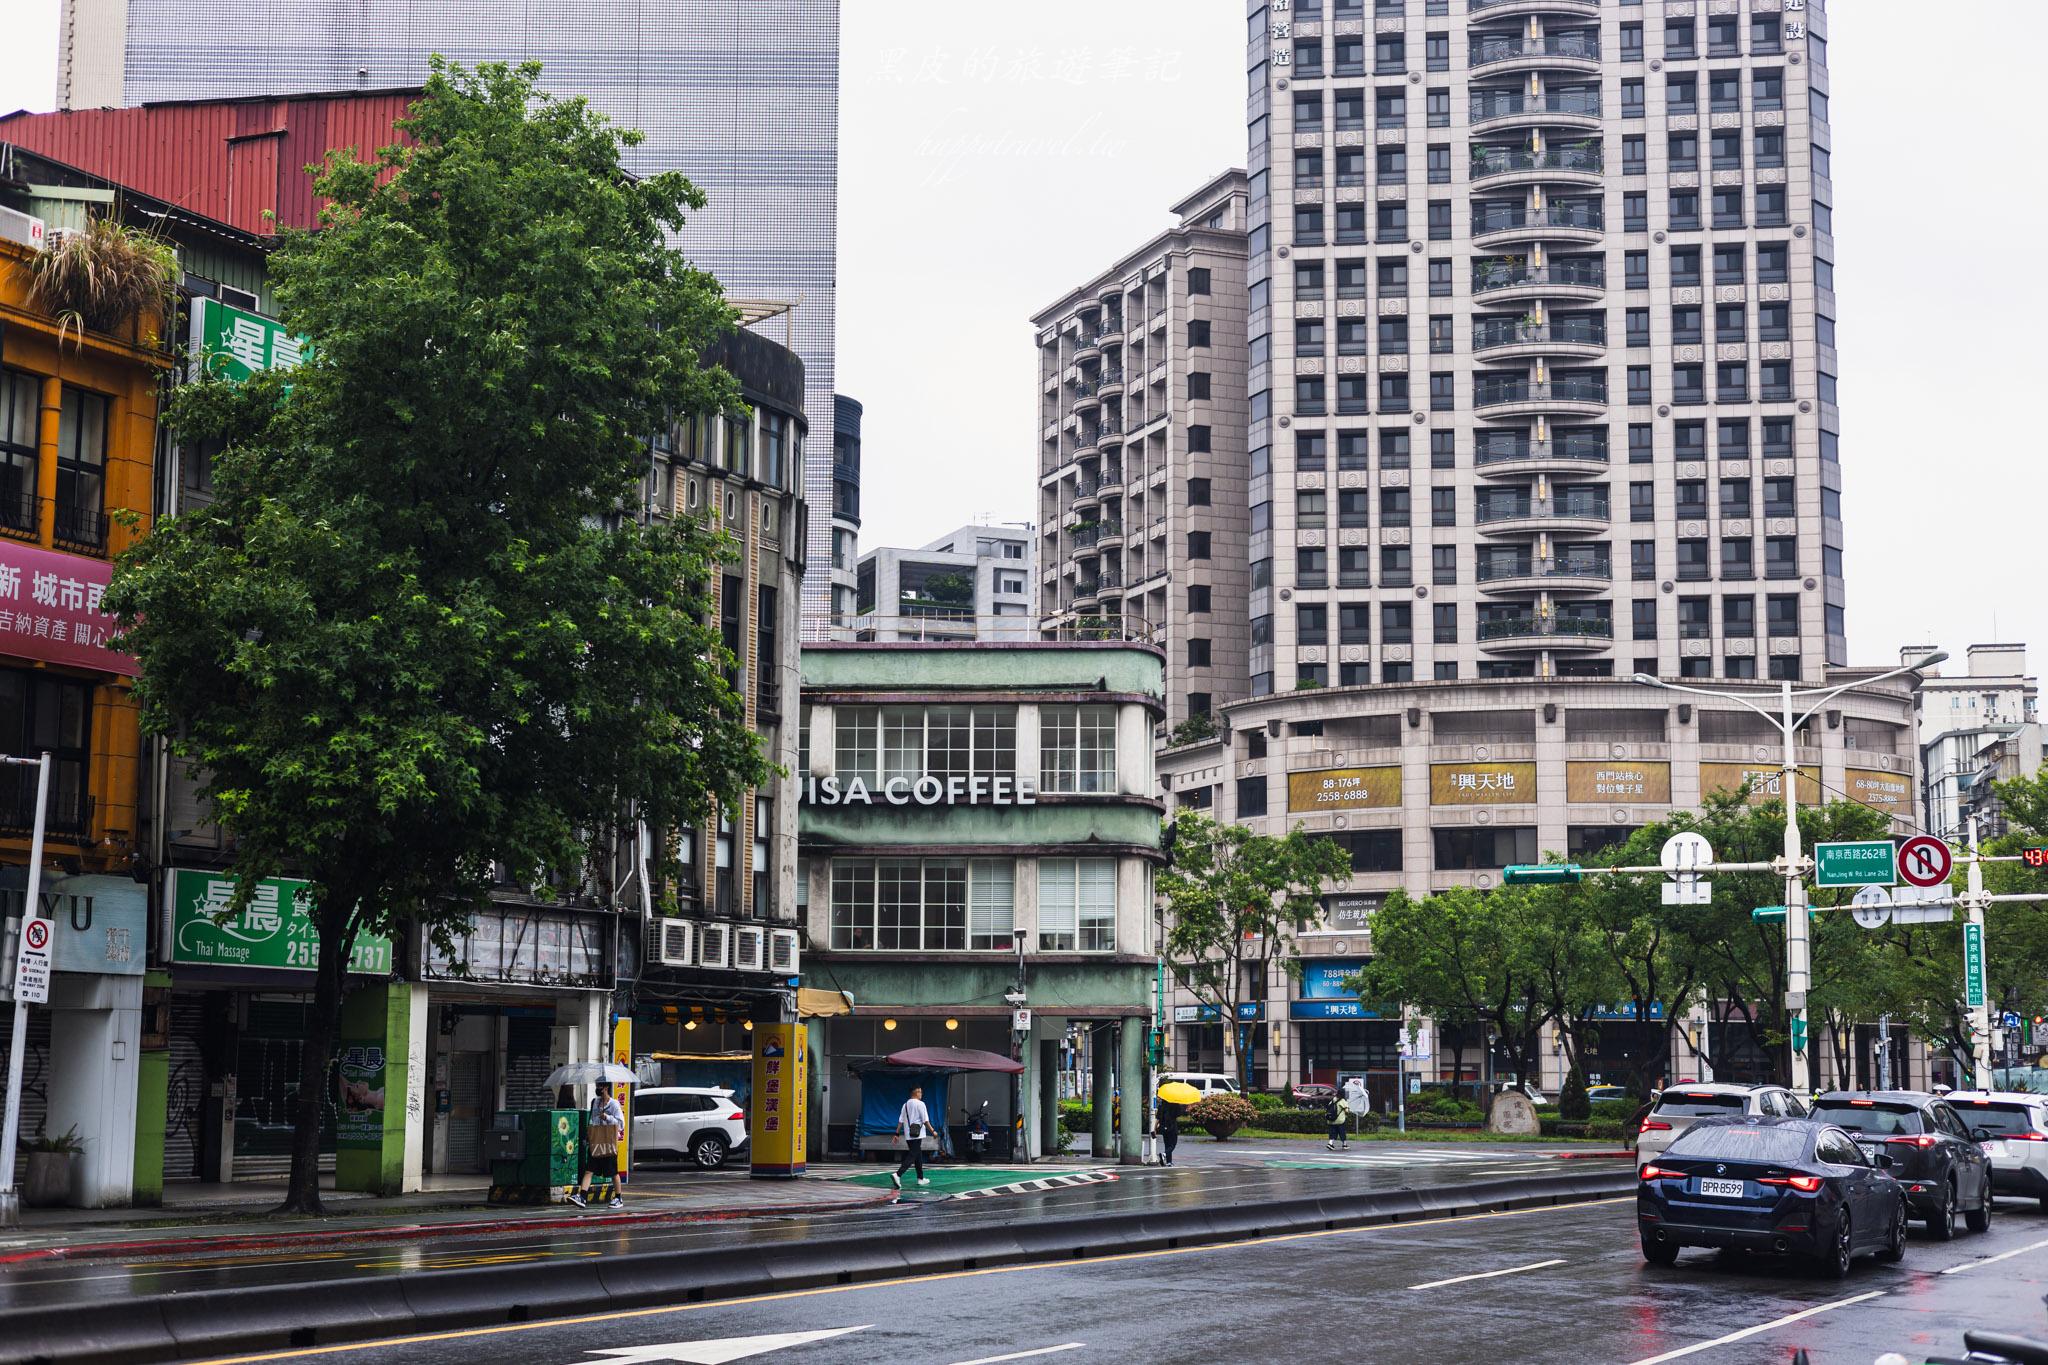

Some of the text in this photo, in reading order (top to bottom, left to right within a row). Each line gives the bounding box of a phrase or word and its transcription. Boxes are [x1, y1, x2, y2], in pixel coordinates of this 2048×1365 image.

[884, 776, 1037, 805] COFFEE
[1323, 777, 1360, 789] 88-176坪
[1458, 772, 1515, 791] 興天地
[1317, 790, 1368, 802] 2558-6888
[1825, 848, 1888, 860] 南京西路262巷
[2025, 849, 2042, 866] 43
[196, 939, 250, 963] Thai Massage
[1969, 932, 1979, 974] 南京西路
[764, 1060, 780, 1131] 鮮堡漢堡
